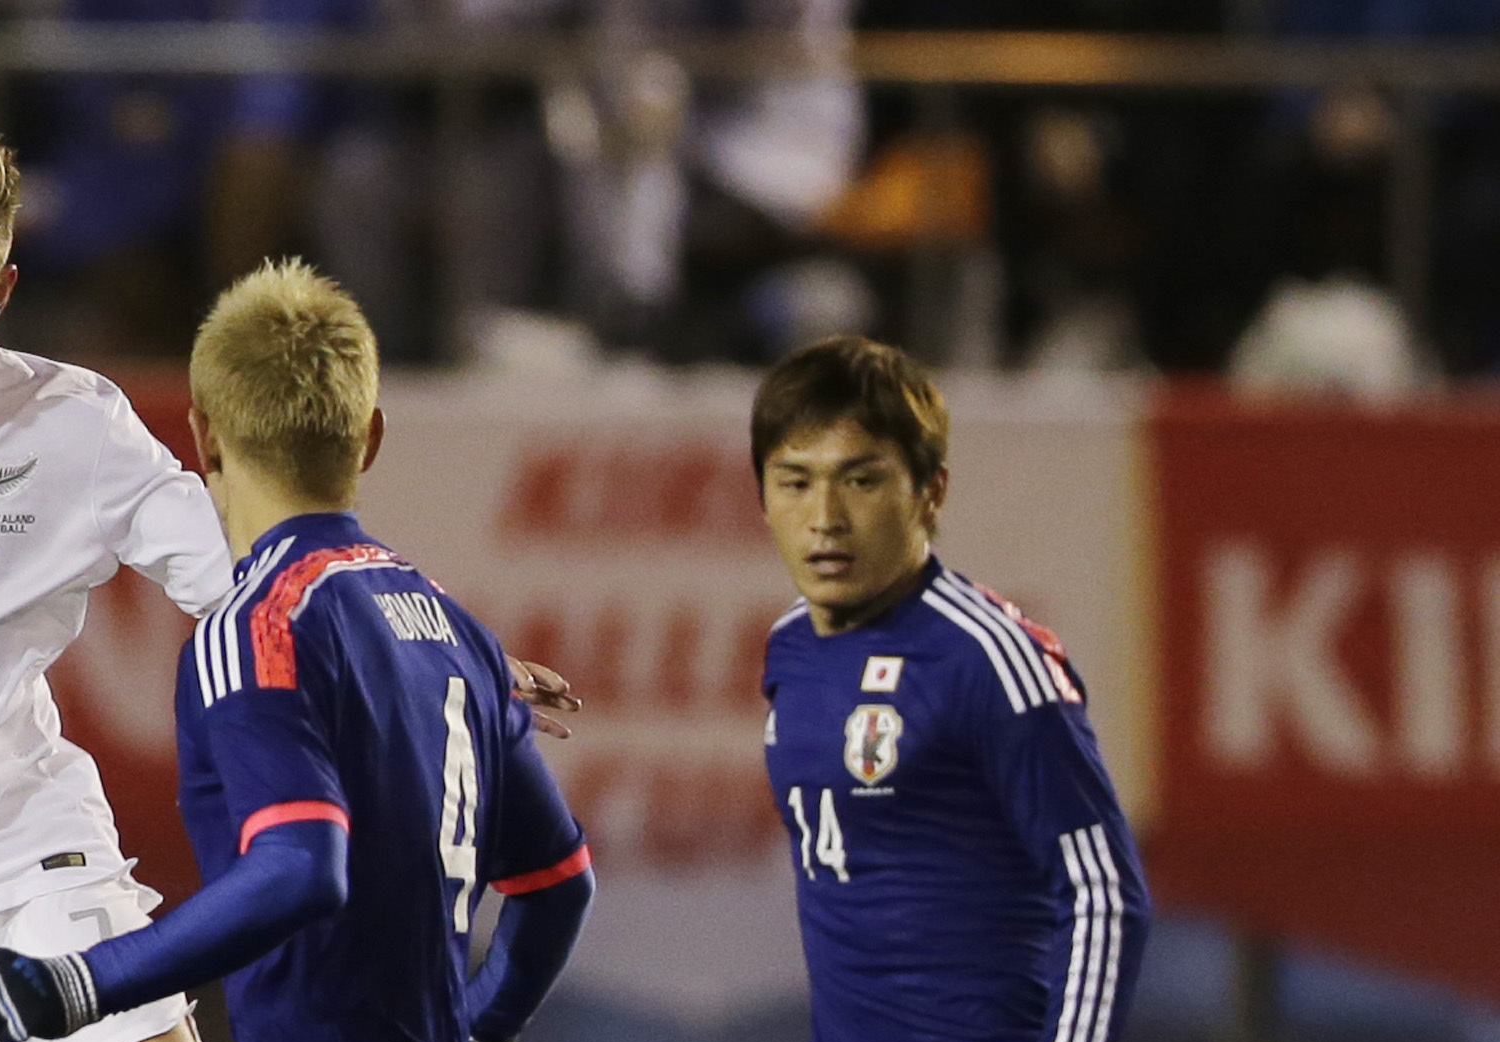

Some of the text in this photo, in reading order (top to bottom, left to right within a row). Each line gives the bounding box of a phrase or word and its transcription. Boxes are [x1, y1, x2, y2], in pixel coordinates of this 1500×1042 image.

[373, 592, 458, 647] HONDA
[1202, 542, 1500, 778] KI
[439, 676, 478, 934] 4
[788, 786, 850, 883] 14
